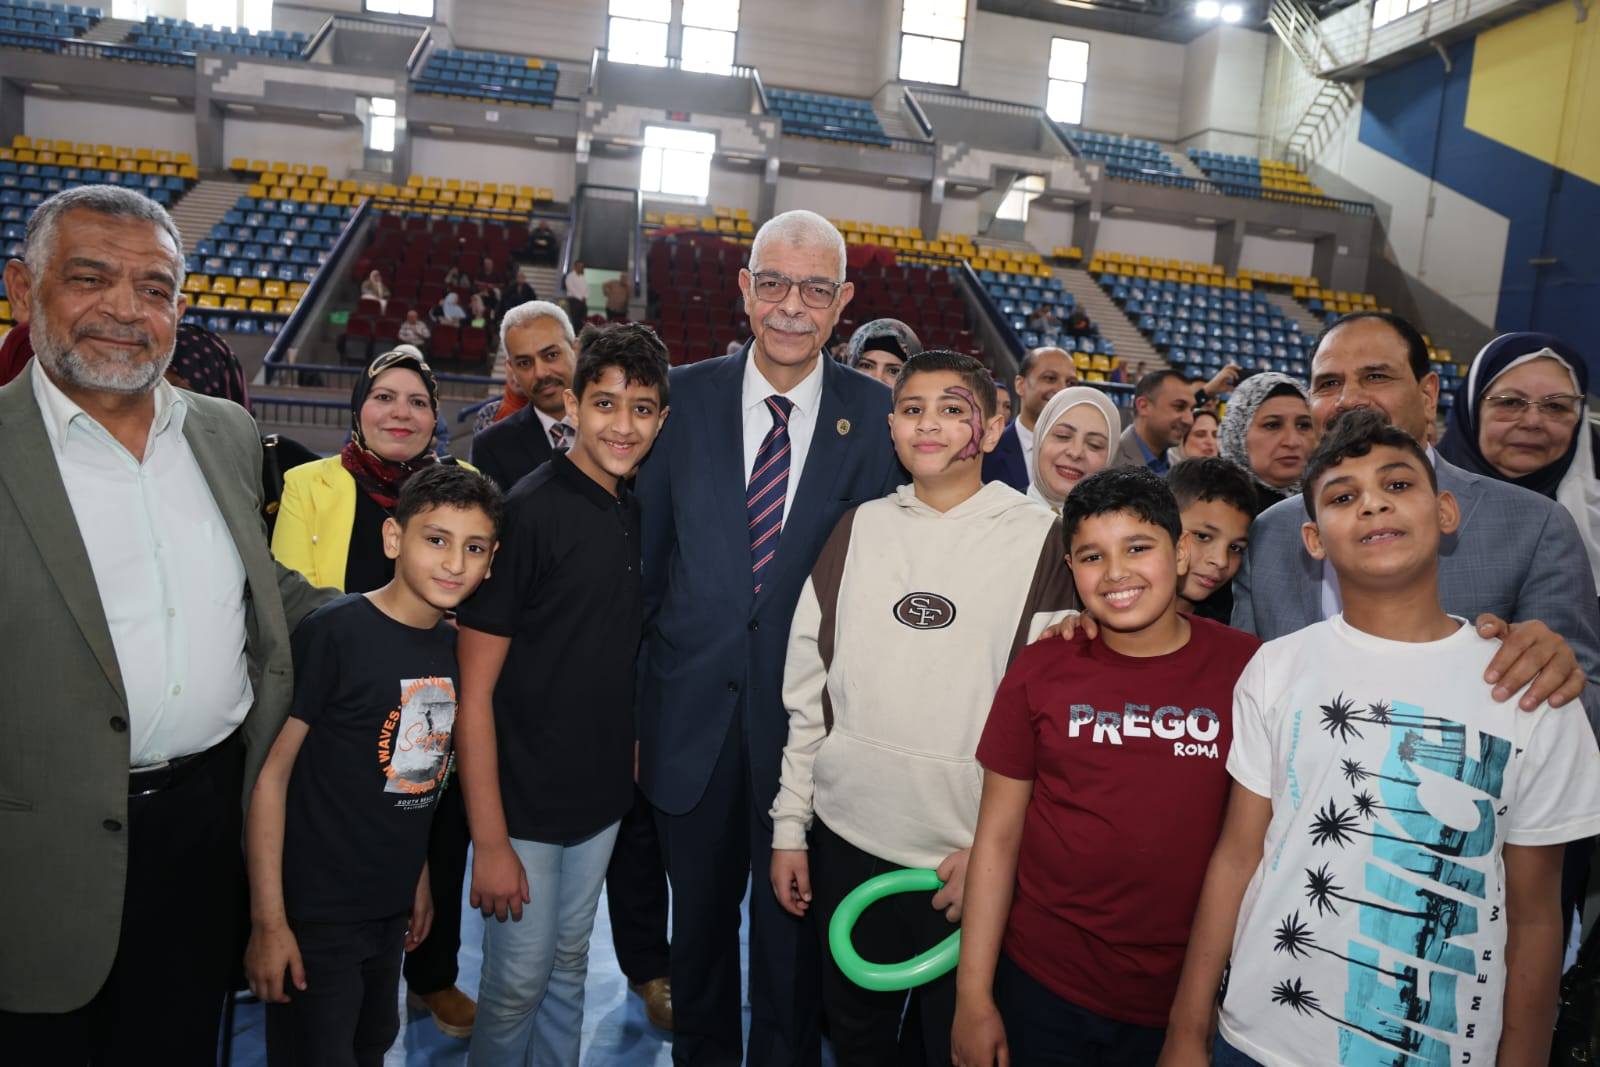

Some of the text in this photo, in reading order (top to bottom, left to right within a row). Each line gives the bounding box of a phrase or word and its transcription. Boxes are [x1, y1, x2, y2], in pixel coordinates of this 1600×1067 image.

[908, 597, 942, 625] SF
[377, 710, 400, 763] WAVES
[1068, 702, 1220, 745] PREGO
[1173, 741, 1219, 759] ROMA
[1462, 949, 1492, 1065] UMMER
